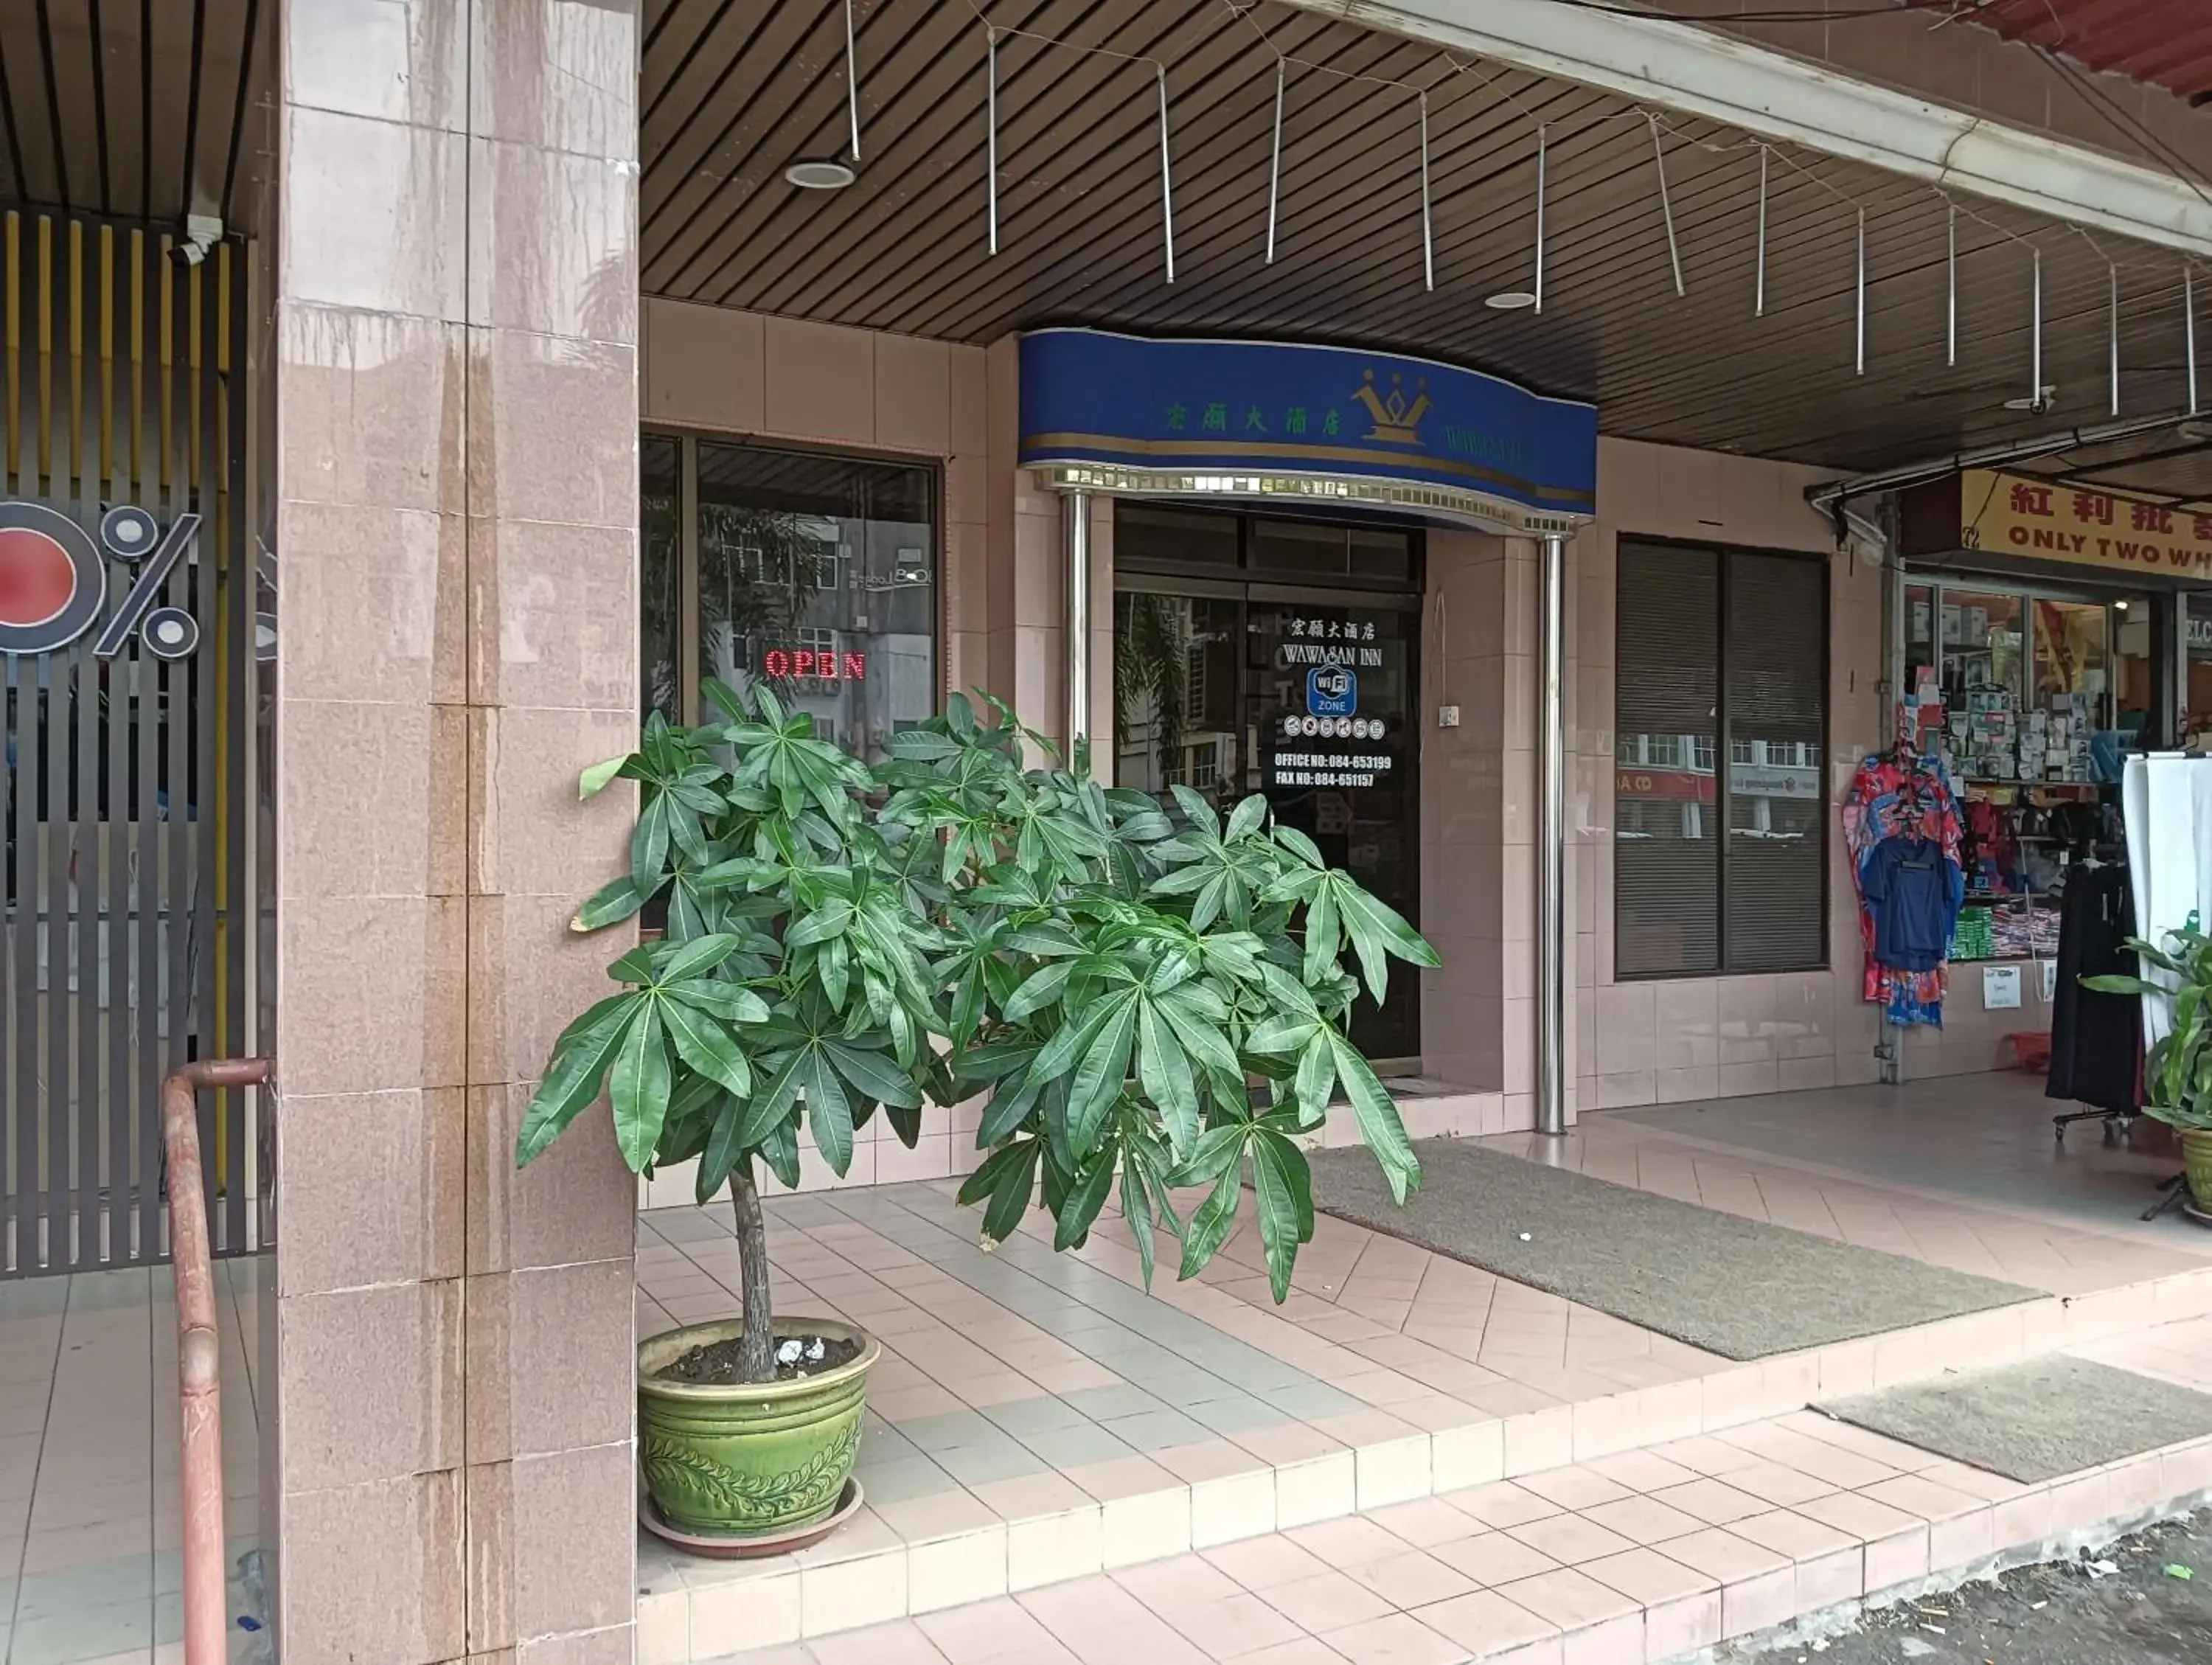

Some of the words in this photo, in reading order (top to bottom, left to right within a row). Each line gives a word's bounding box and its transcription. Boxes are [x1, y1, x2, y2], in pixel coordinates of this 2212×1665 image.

[2009, 526, 2087, 554] ONLY
[2097, 537, 2160, 563] TWO
[1283, 644, 1355, 665] WAWASAN
[1360, 648, 1382, 667] INN
[765, 649, 867, 681] OPEN
[1318, 701, 1346, 712] ZONE
[1275, 753, 1310, 767] OFFICE
[1276, 771, 1295, 785] FAX
